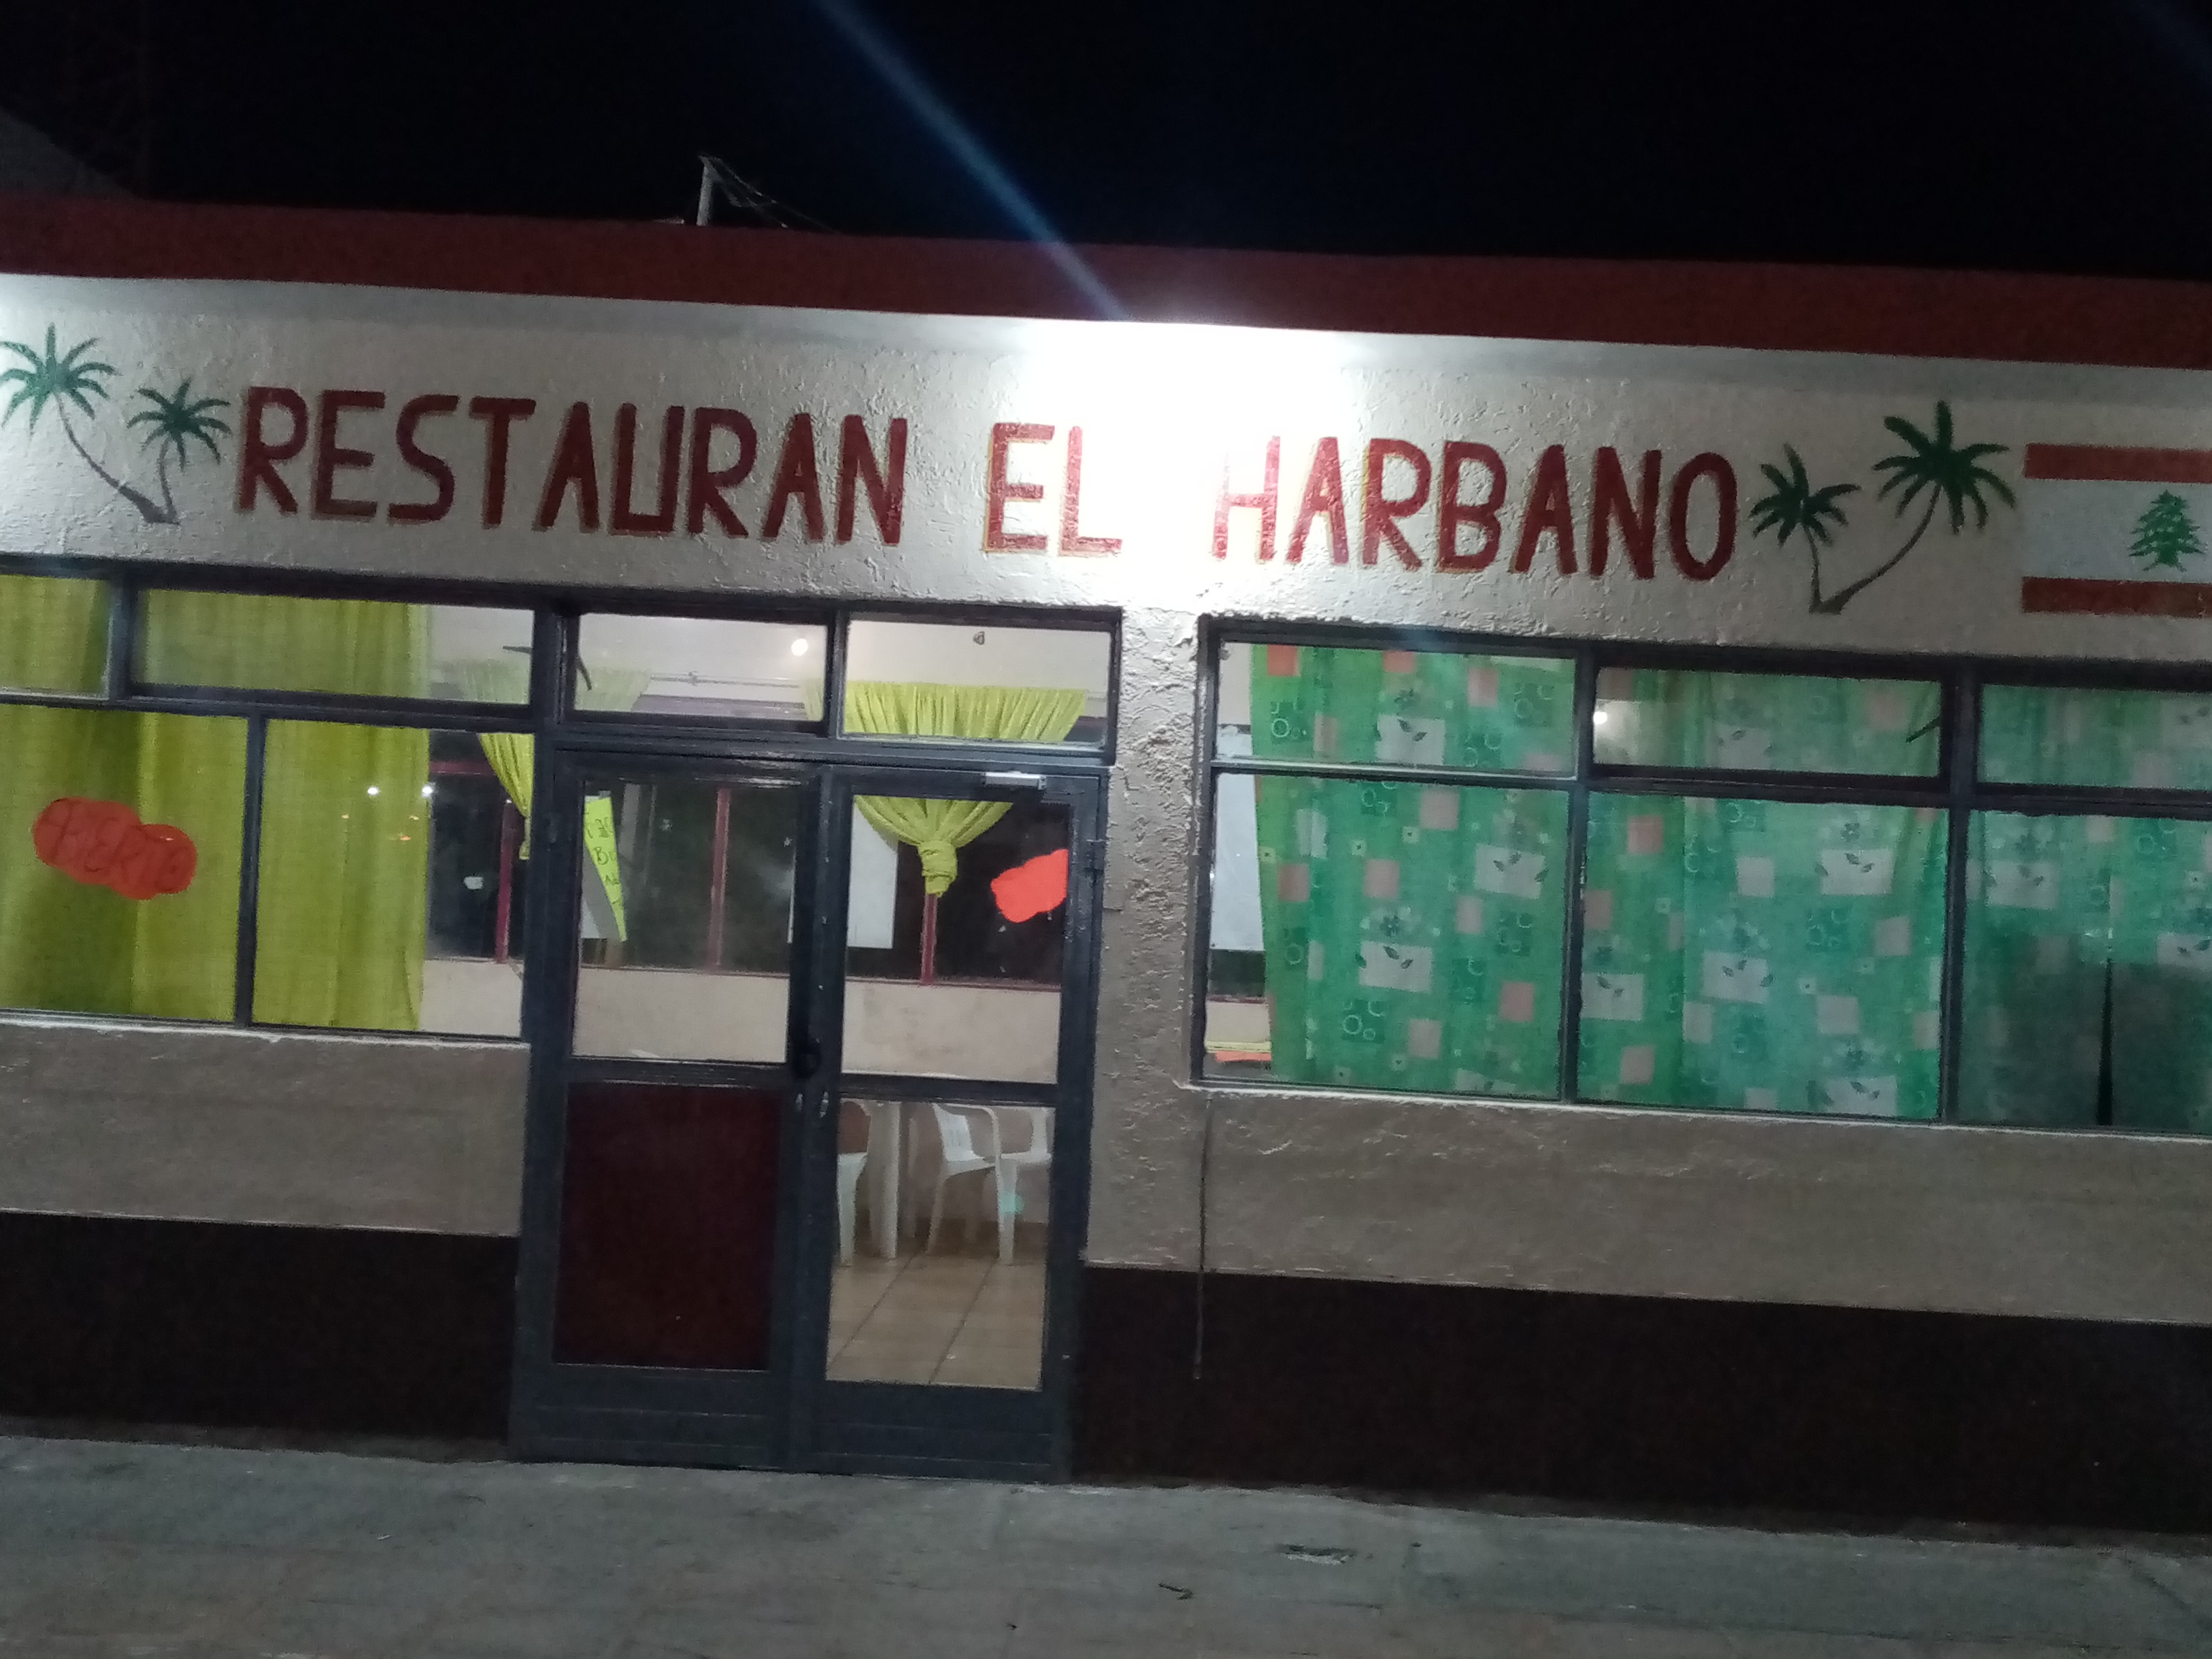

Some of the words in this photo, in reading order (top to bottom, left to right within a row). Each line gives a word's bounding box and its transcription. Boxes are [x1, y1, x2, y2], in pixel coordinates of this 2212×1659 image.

[235, 385, 908, 546] RESTAURAN
[983, 422, 1123, 558] EL
[1211, 435, 1737, 582] HARBANO
